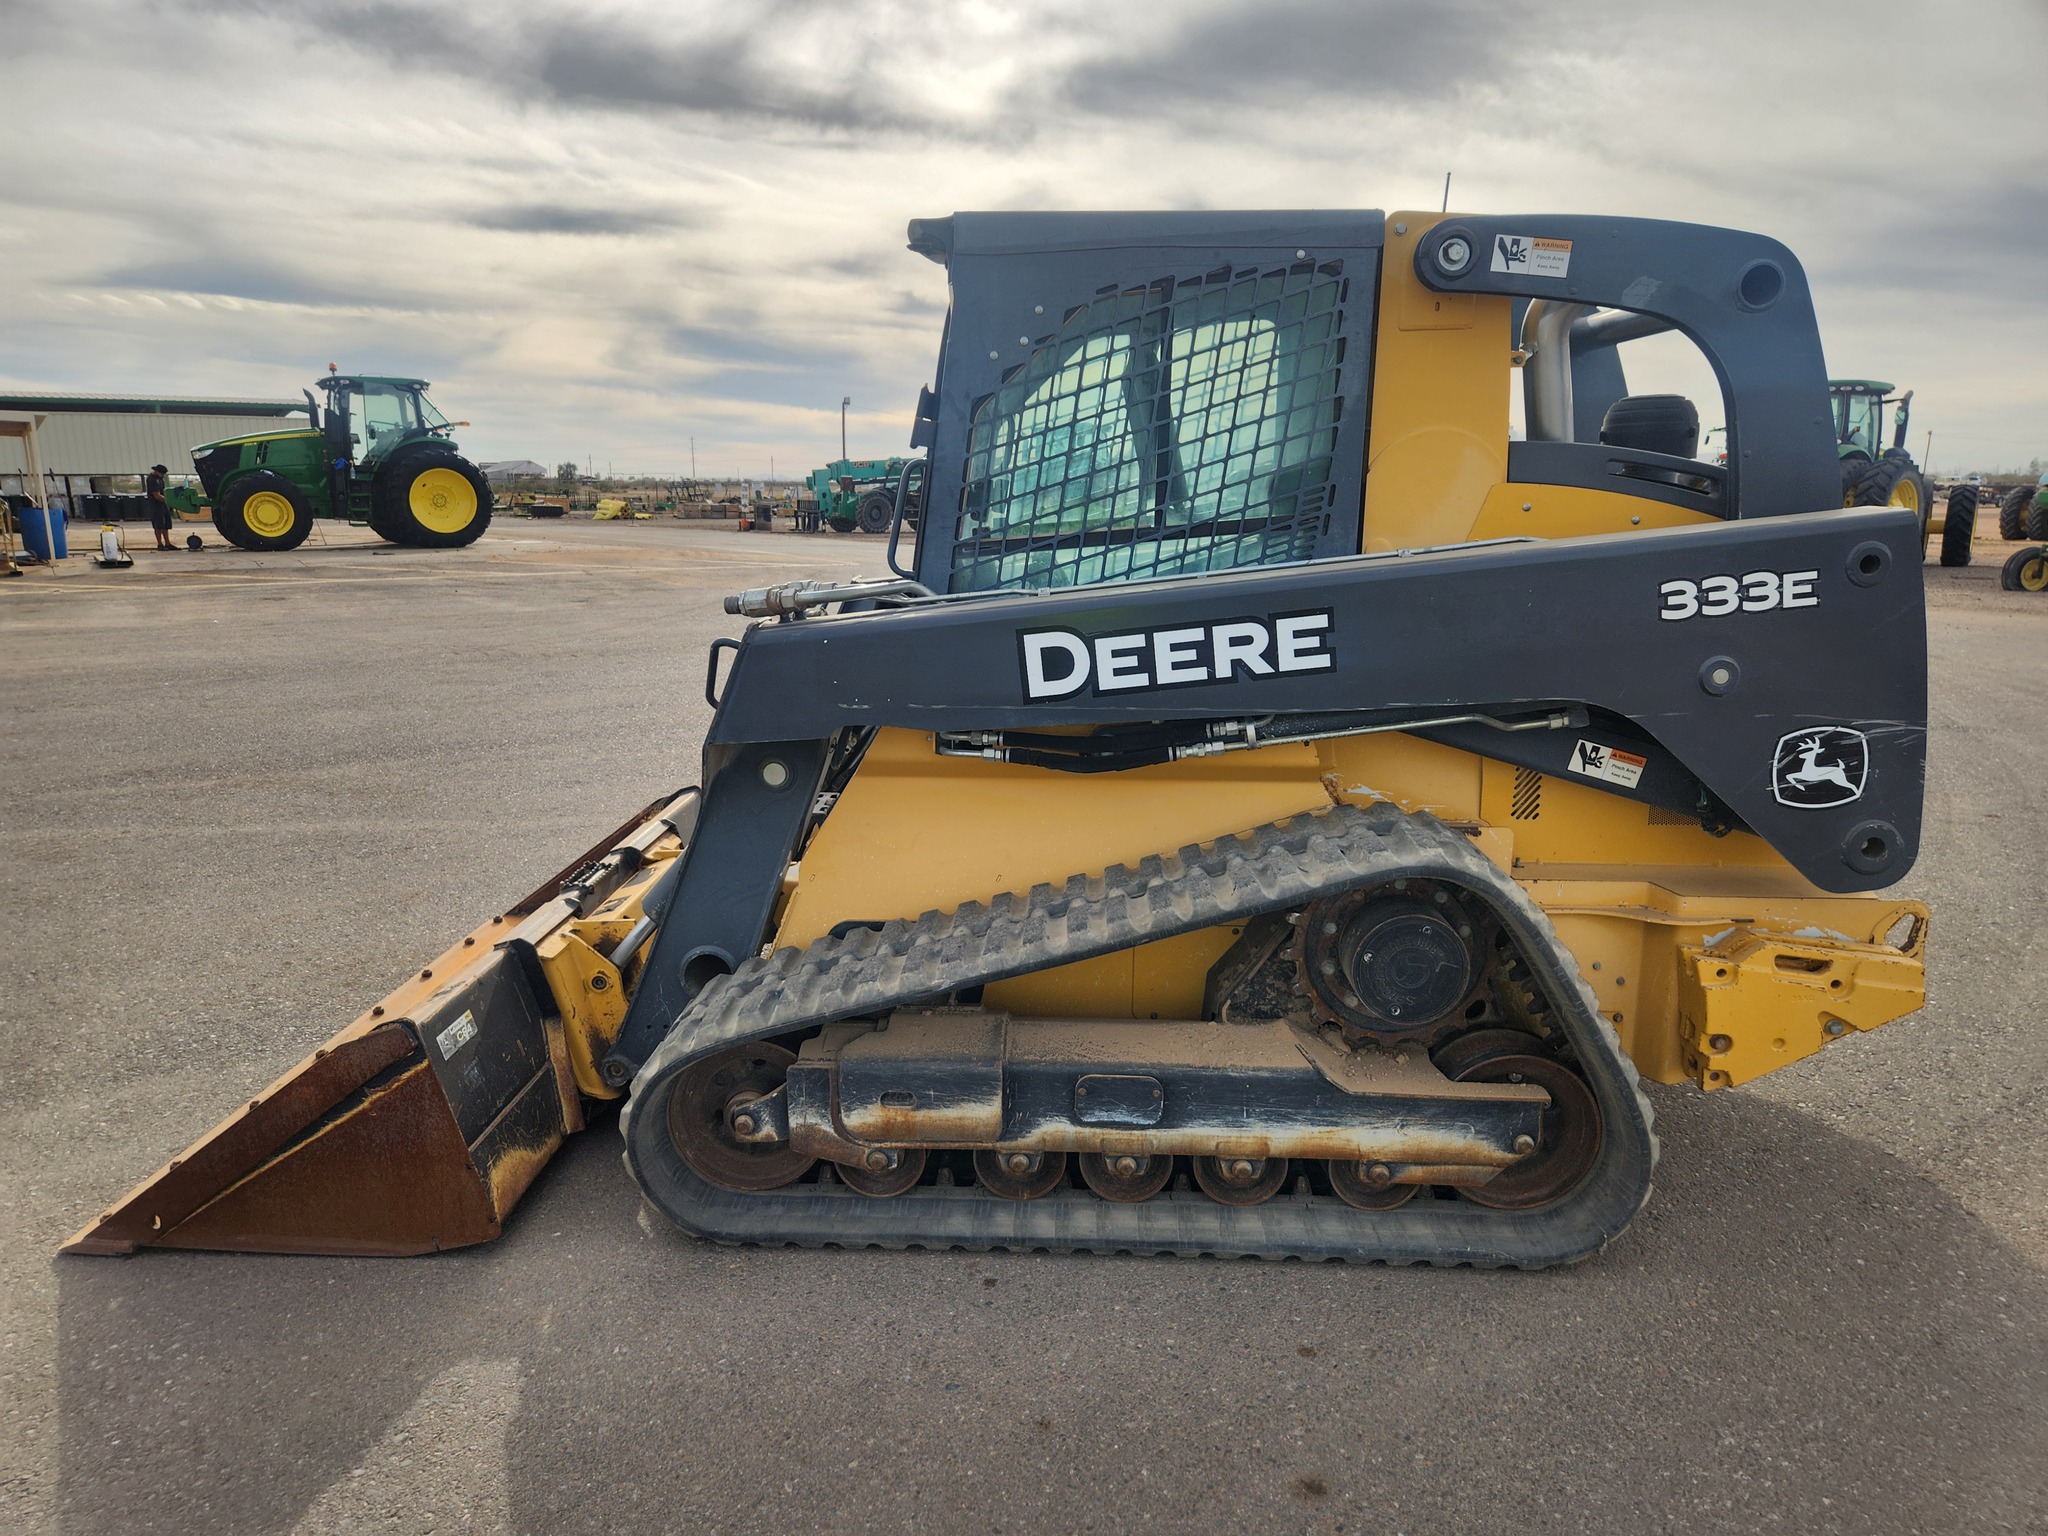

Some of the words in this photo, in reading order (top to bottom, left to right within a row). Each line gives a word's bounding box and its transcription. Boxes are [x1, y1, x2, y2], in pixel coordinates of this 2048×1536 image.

[1541, 242, 1569, 250] WARNING
[1660, 570, 1818, 620] 333E
[1023, 614, 1331, 698] DEERE
[1618, 753, 1644, 765] WARNING
